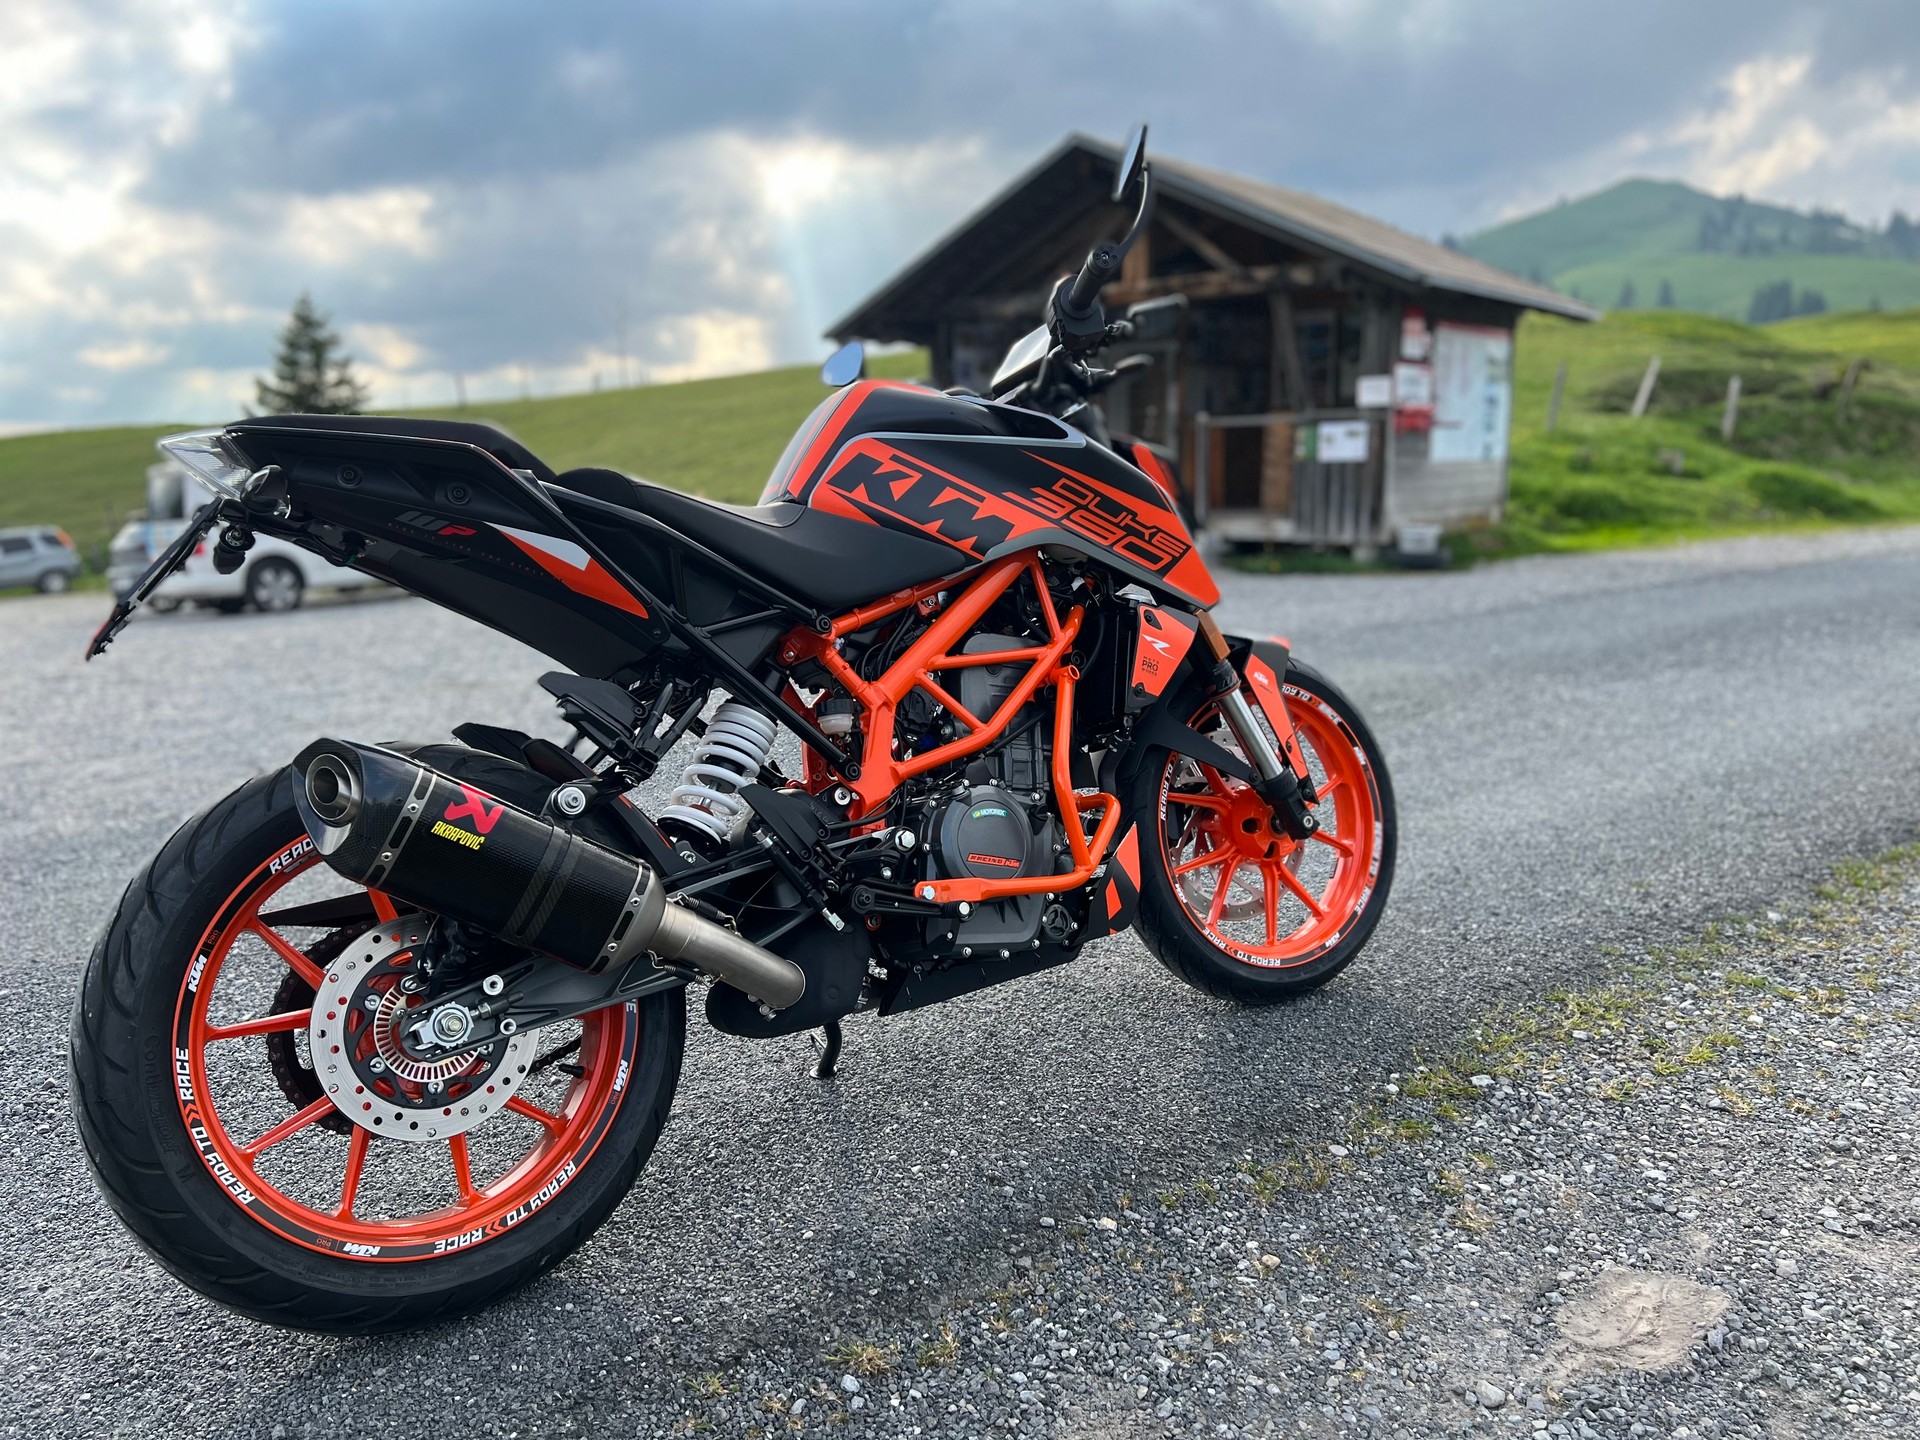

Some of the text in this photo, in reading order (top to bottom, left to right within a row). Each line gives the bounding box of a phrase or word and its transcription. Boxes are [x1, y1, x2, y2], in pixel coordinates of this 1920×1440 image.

[394, 511, 478, 536] WP
[826, 452, 1015, 557] KTM
[1051, 477, 1187, 558] DUKE
[1001, 486, 1173, 571] 390
[1142, 660, 1159, 672] PRO
[1160, 764, 1174, 821] READY TO
[269, 837, 314, 875] READ
[1203, 927, 1281, 966] READY TO RACE
[188, 954, 208, 993] KTM
[613, 1059, 629, 1092] KTM
[175, 1047, 256, 1205] READY TO RACE
[433, 1160, 577, 1253] READY TO RACE
[342, 1242, 381, 1257] KTM
